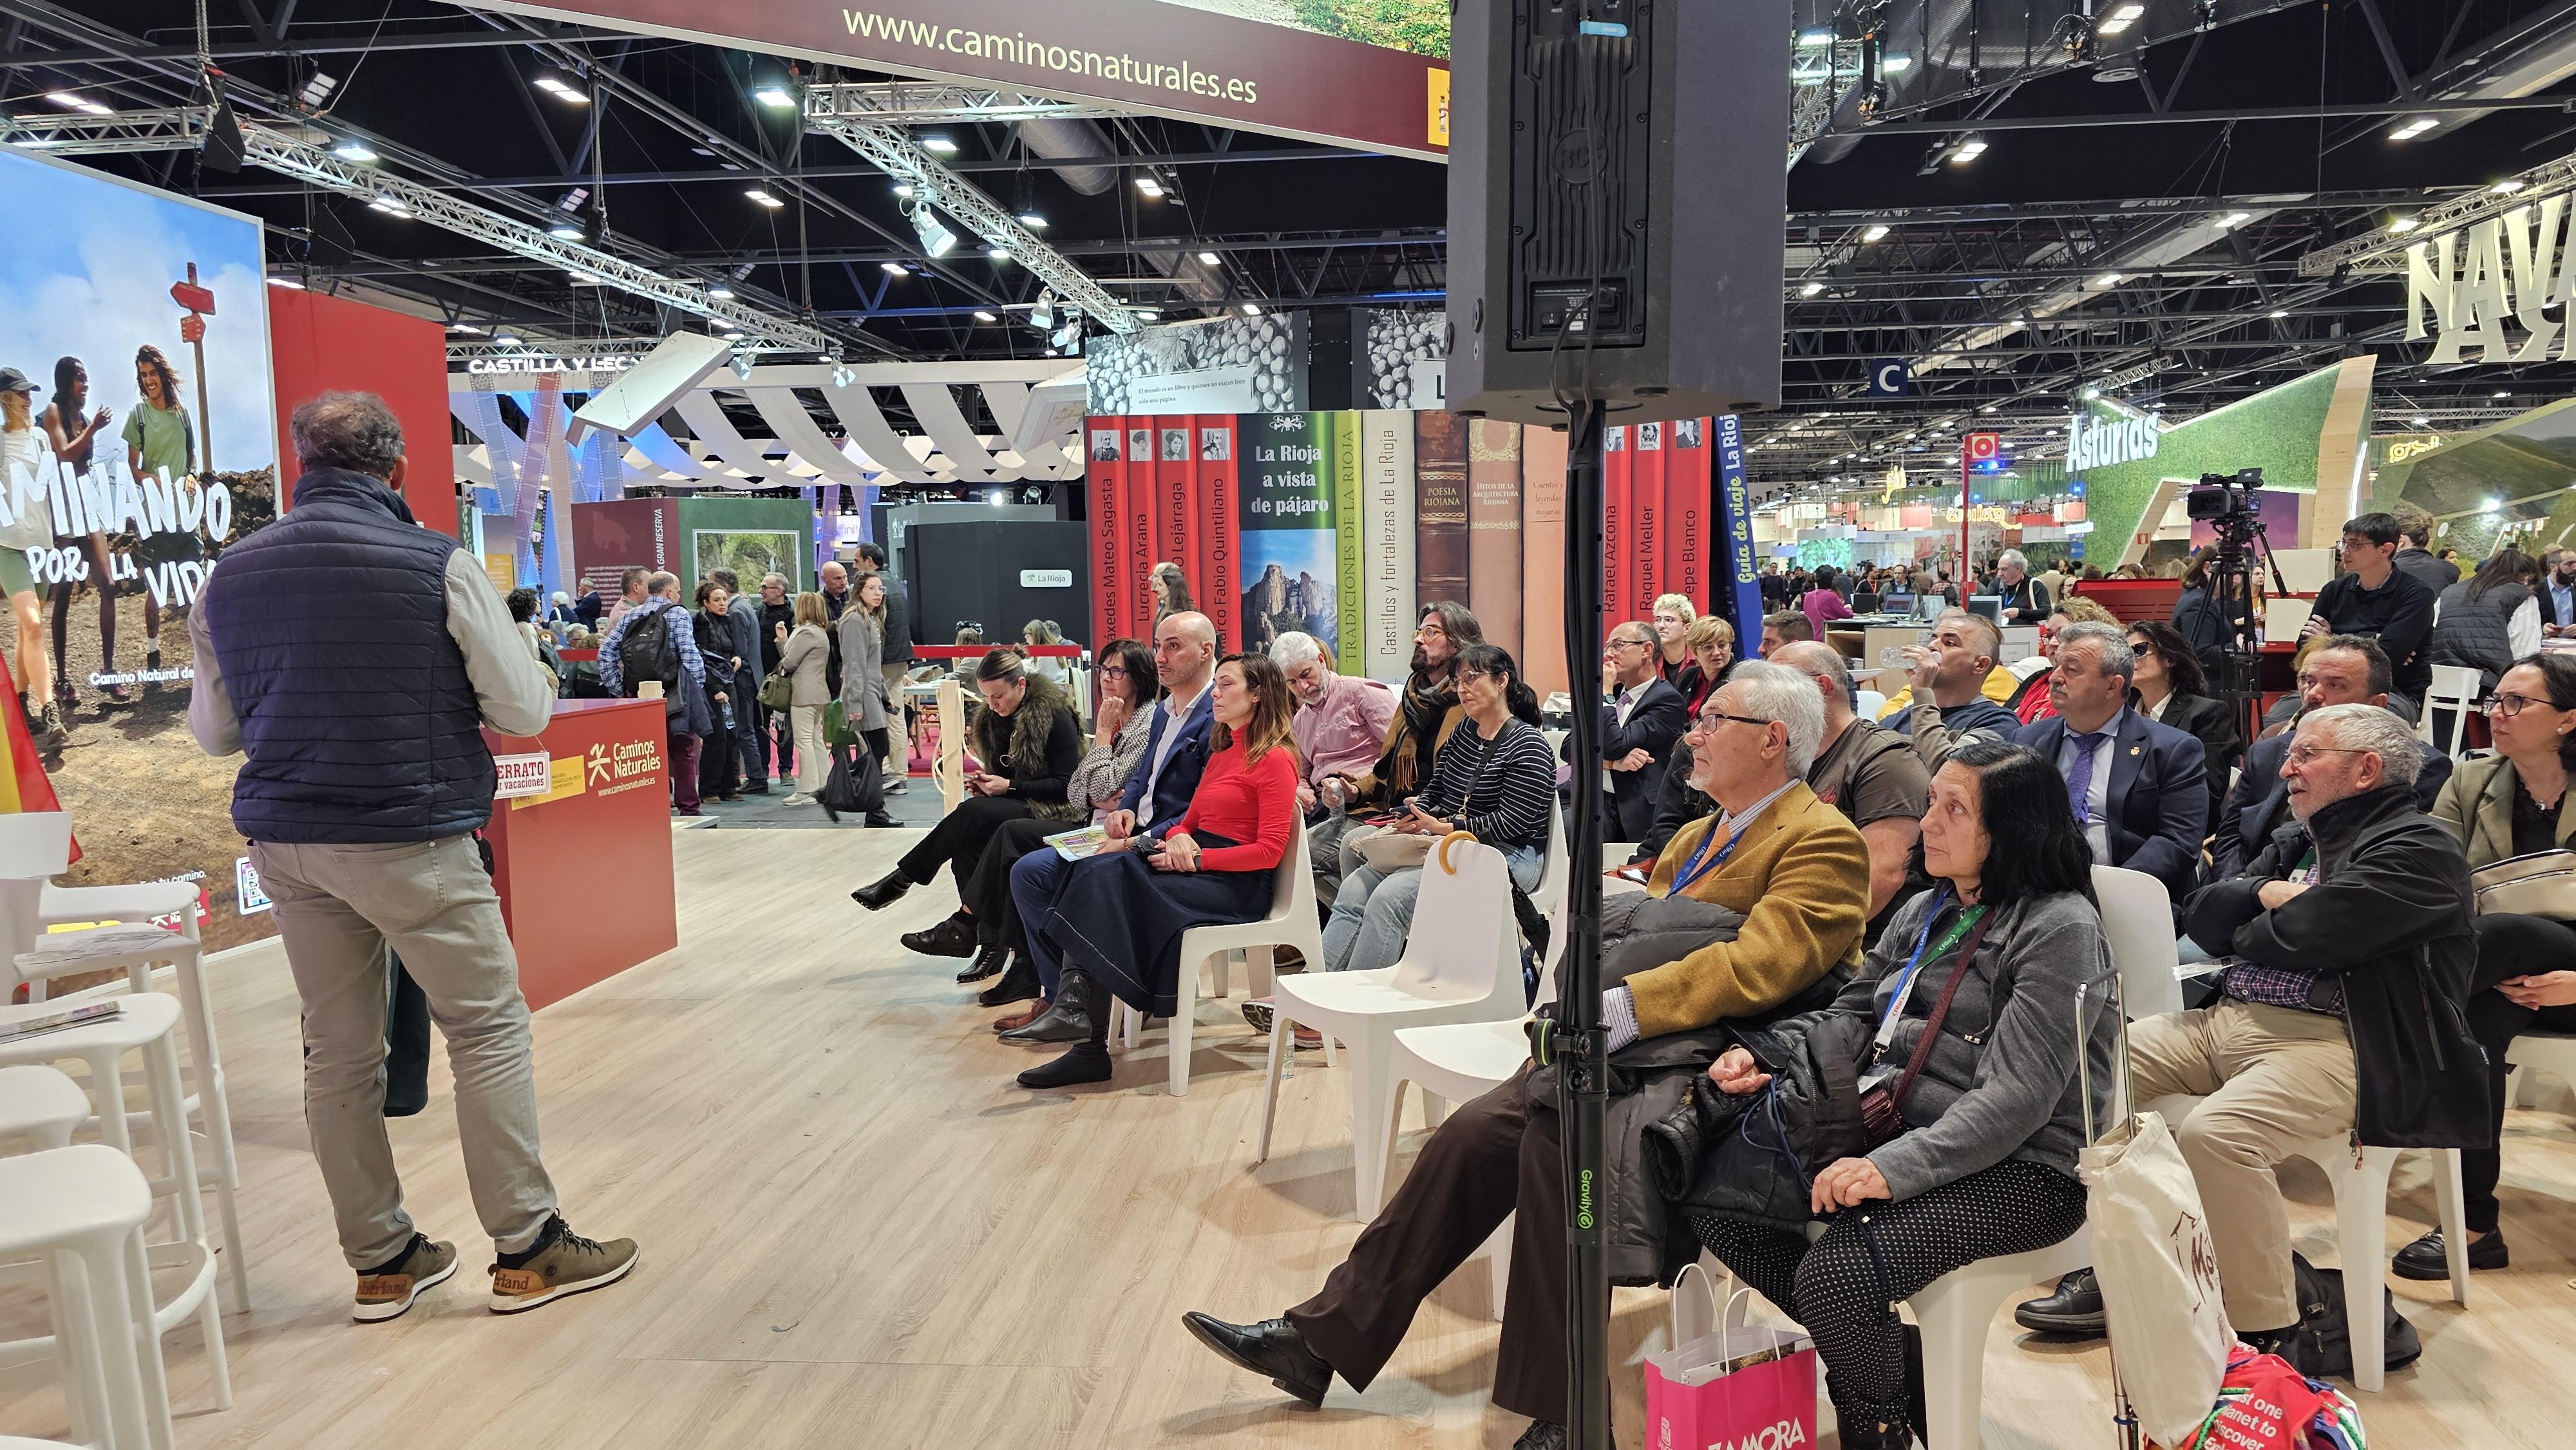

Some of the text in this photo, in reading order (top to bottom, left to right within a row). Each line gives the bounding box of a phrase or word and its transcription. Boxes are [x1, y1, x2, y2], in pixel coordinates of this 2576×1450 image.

[843, 9, 1258, 104] www.caminosnaturales.es
[469, 358, 568, 374] CASTILLA
[573, 357, 587, 372] Y
[1879, 364, 1900, 392] C
[1256, 445, 1323, 464] La Rioja
[1379, 429, 1398, 462] Rioja
[2066, 411, 2159, 473] Asturias
[1263, 471, 1317, 488] a vista
[1380, 466, 1395, 485] La
[1428, 487, 1457, 496] POESIA
[1251, 496, 1329, 516] de pájaro
[1379, 489, 1396, 505] de
[1424, 497, 1461, 507] RIOJANA
[1719, 413, 1756, 583] Guía de viaje La Rioj
[654, 508, 664, 543] RESERVA
[1170, 482, 1186, 552] Lejárraga
[1211, 478, 1228, 561] Quintiliano
[1341, 430, 1357, 663] TRADICIONES DE LA RIOJA
[1380, 509, 1397, 581] fortalezas
[1682, 510, 1696, 562] Blanco
[25, 545, 89, 584] POR
[109, 552, 138, 581] LA
[656, 543, 665, 565] GRAN
[1101, 478, 1117, 643] áxedes Mateo Sagasta
[1136, 513, 1150, 621] Lucrecia Arana
[1604, 505, 1616, 612] Rafael Azcona
[1640, 505, 1656, 610] Raquel Meller
[1047, 574, 1066, 583] Rioja
[1214, 565, 1227, 605] Fabio
[1381, 594, 1397, 655] Castillos
[90, 670, 136, 686] Camino
[138, 666, 180, 683] Natural
[613, 739, 655, 761] Caminos
[614, 755, 661, 778] Naturales
[496, 761, 544, 779] ERRATO
[504, 778, 544, 790] vacaciones
[598, 777, 656, 797] www.caminosnaturales.es
[1579, 1169, 1593, 1212] Gravity
[2221, 1404, 2277, 1437] lanet to
[2254, 1398, 2283, 1419] one
